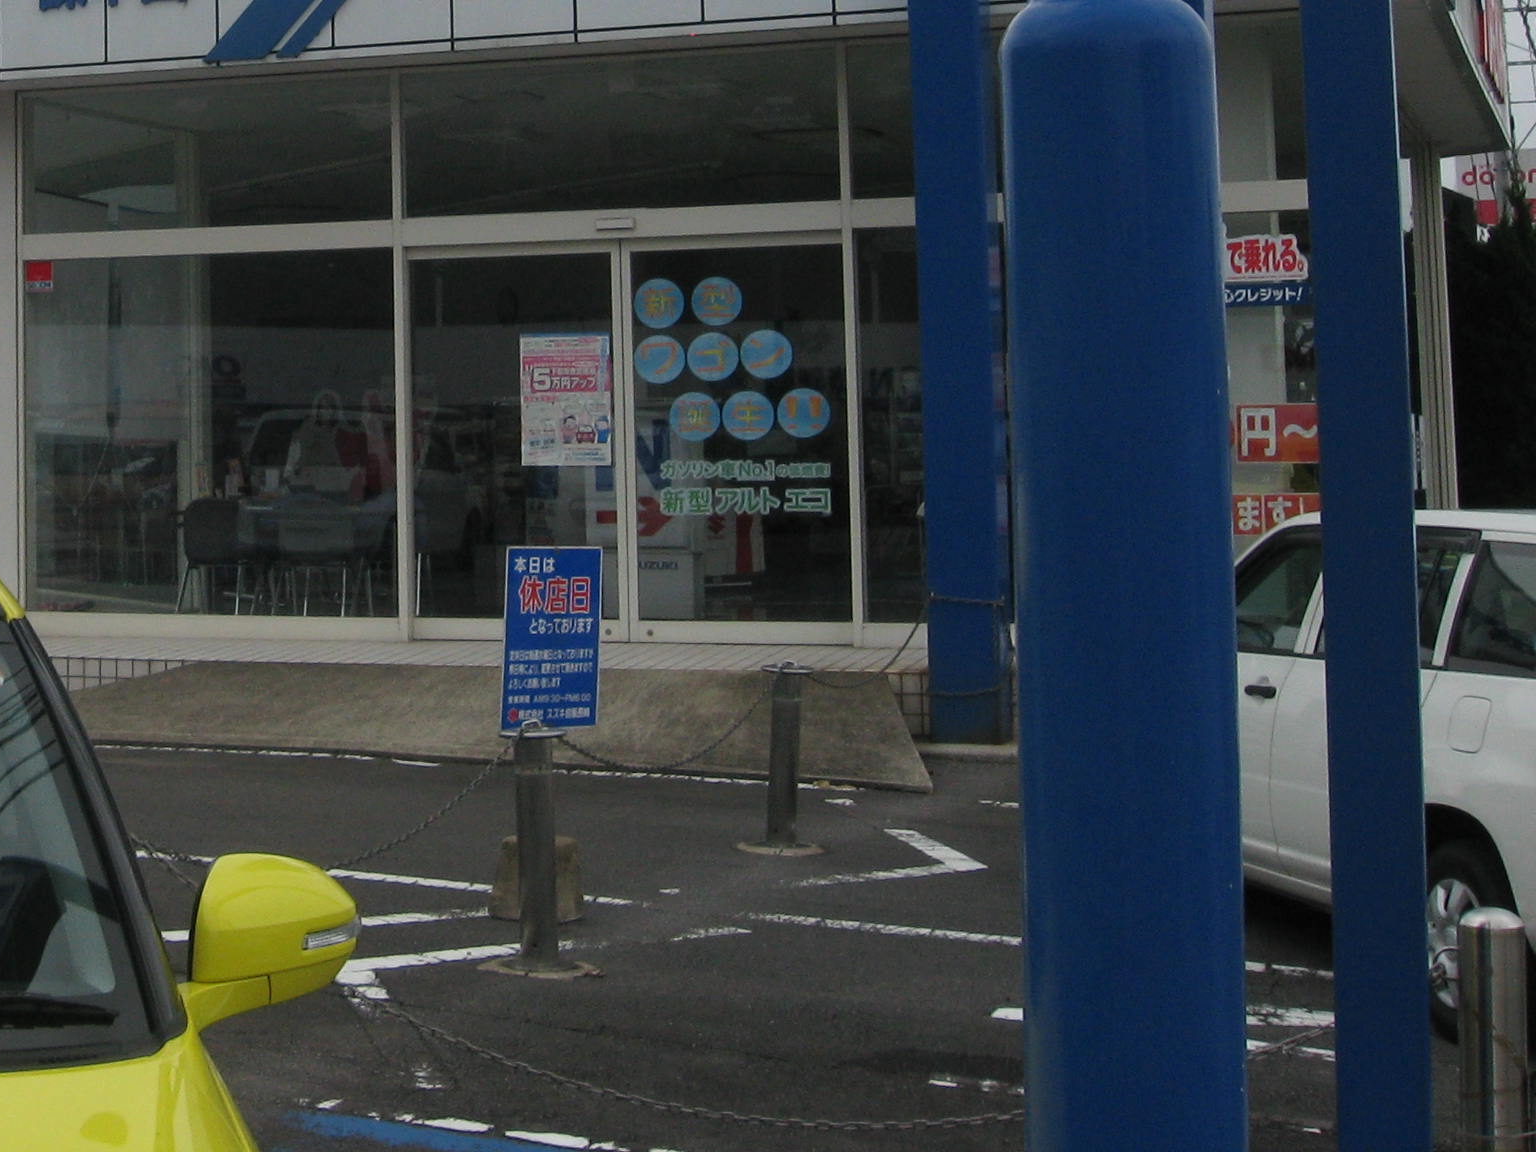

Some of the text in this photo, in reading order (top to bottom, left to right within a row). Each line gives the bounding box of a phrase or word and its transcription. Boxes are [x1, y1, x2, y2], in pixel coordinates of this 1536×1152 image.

[1226, 238, 1305, 274] で乗れる。
[641, 338, 785, 375] ワゴン
[514, 556, 556, 574] 本日は
[518, 575, 591, 614] 休店日
[529, 617, 593, 635] となっております
